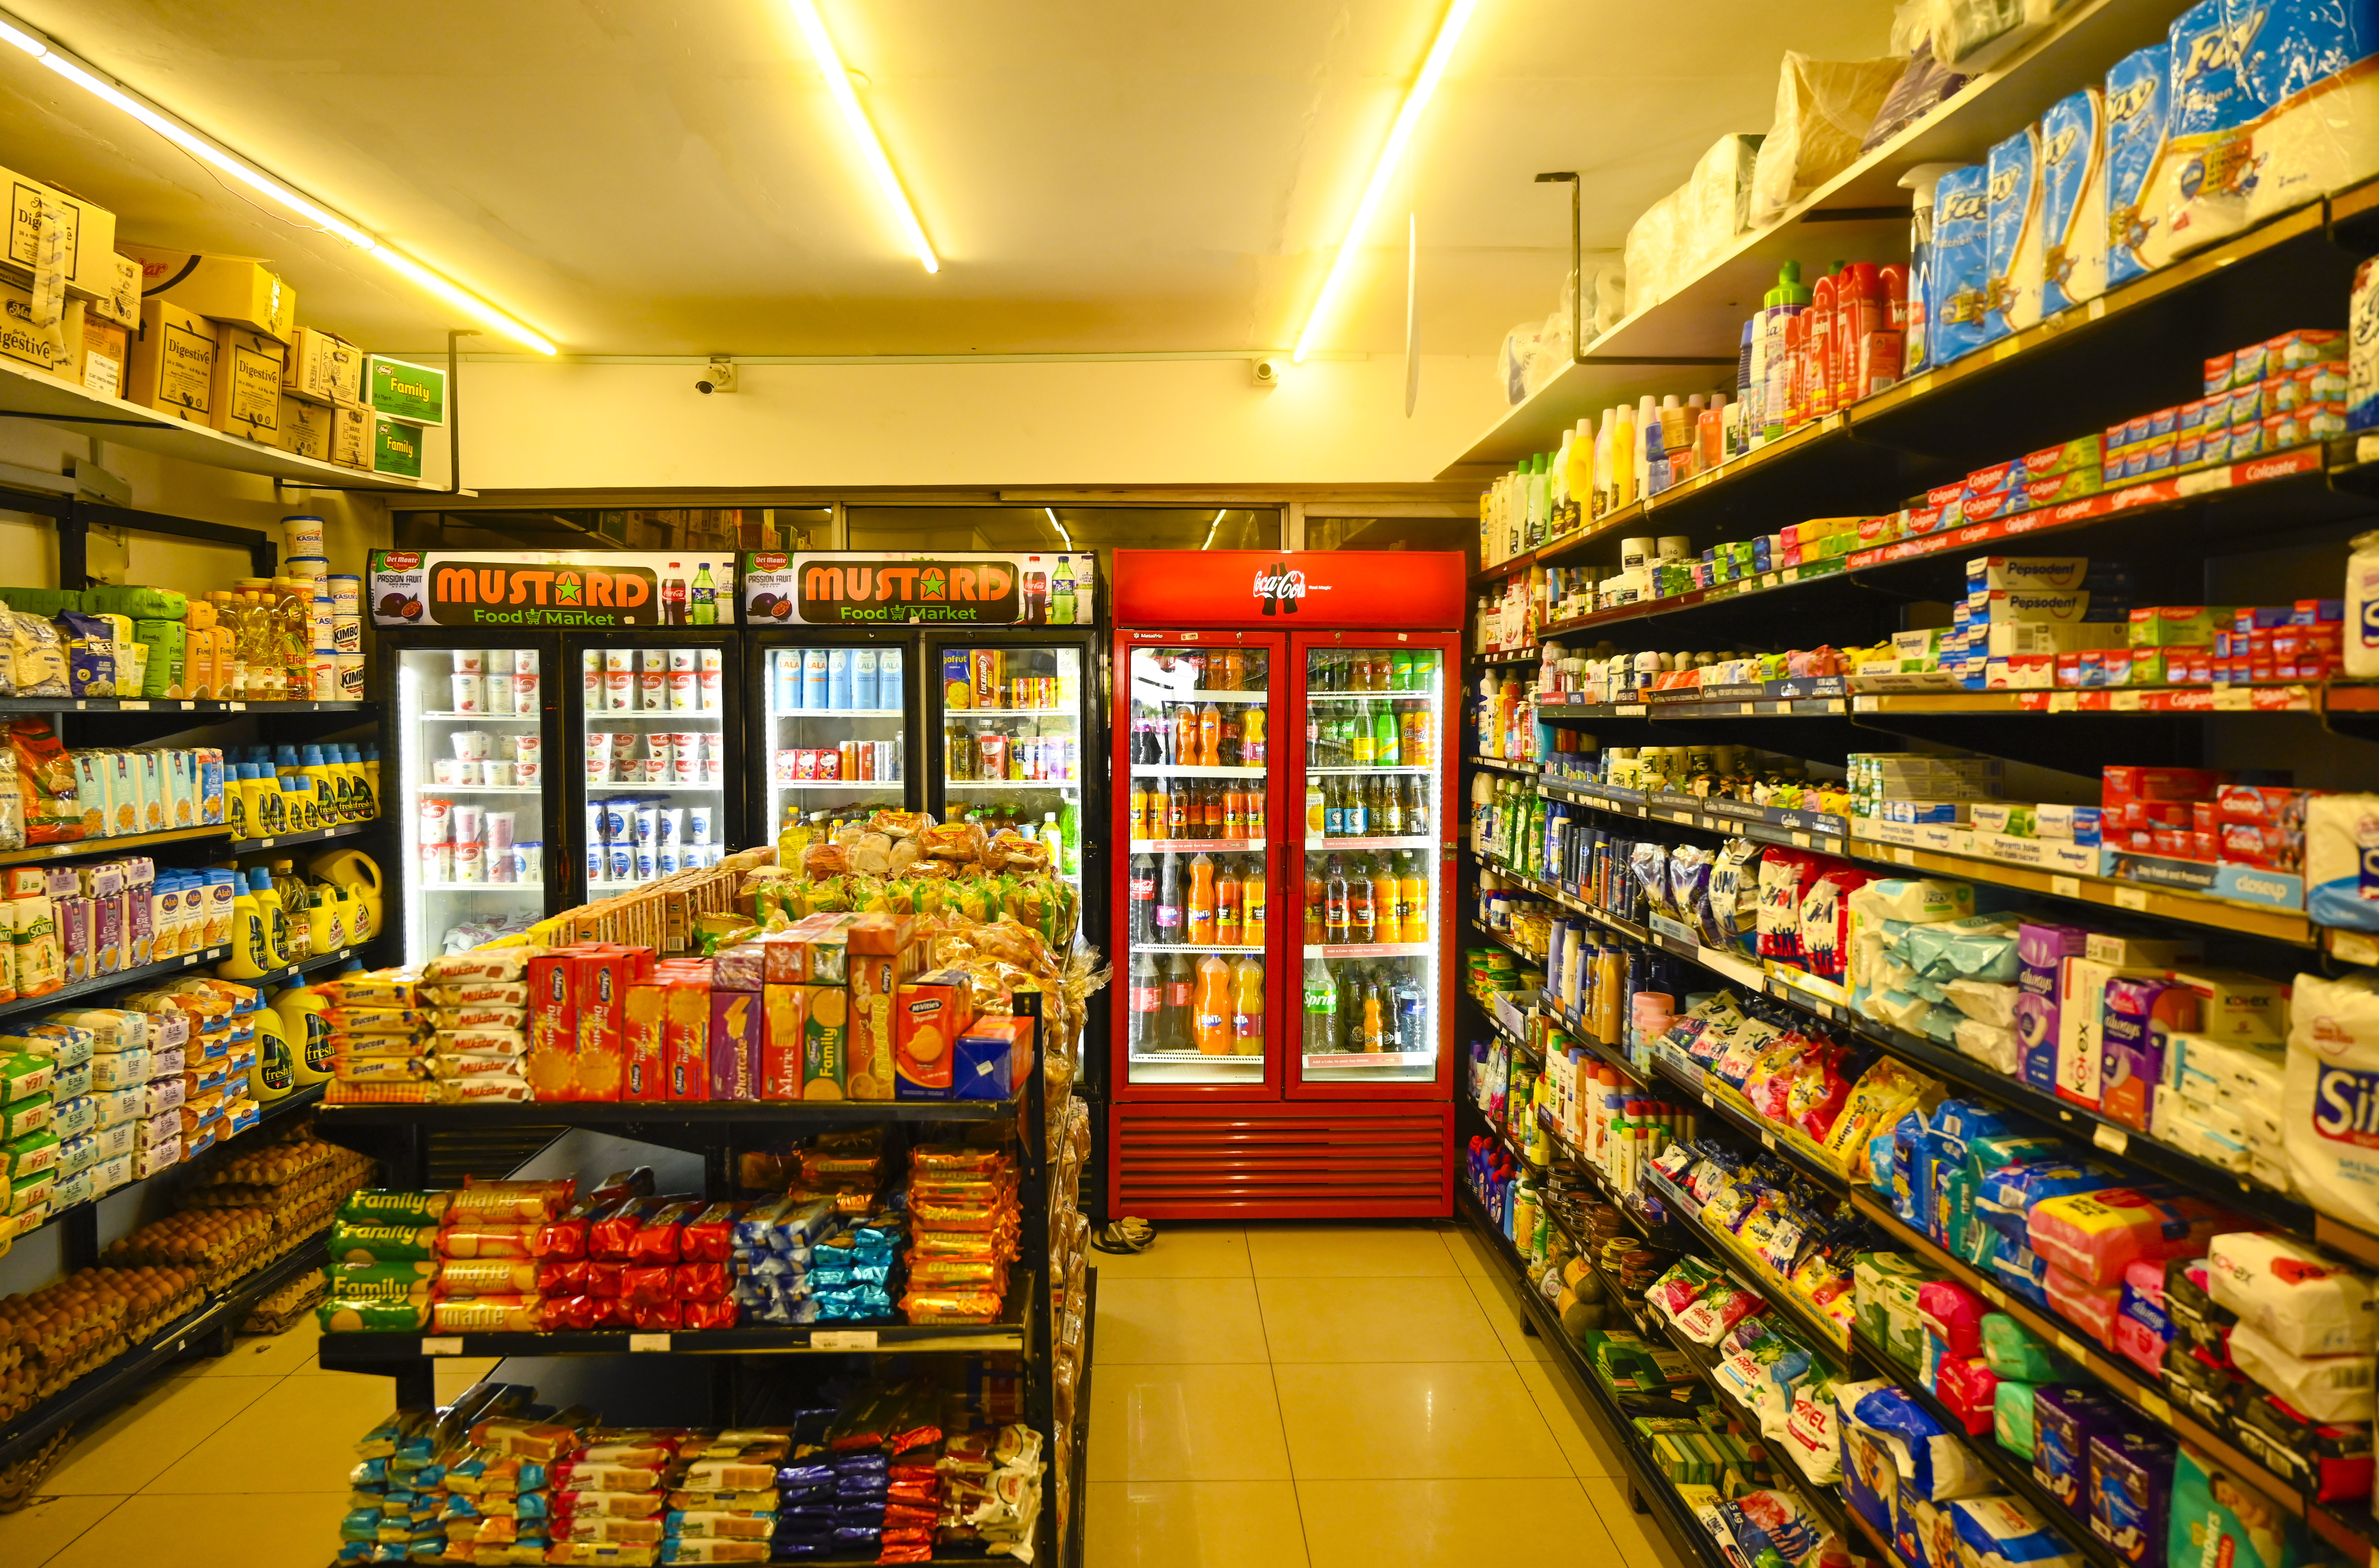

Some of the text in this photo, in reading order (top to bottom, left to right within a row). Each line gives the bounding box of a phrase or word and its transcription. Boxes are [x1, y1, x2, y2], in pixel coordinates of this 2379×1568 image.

[0, 326, 50, 359] igestive
[168, 338, 209, 364] Digestive
[239, 360, 277, 384] Digestive
[390, 377, 430, 403] Family
[387, 436, 414, 458] Family
[2027, 450, 2059, 468] Colgate
[2245, 458, 2297, 480] Colgate
[1967, 470, 2003, 488] Colgate
[2029, 479, 2061, 496] Colgate
[1928, 488, 1960, 503] Colgate
[1963, 497, 2001, 514] Colgate
[2056, 502, 2092, 519] Colgate
[1909, 513, 1938, 528] Colgate
[296, 532, 322, 542] KASUKU
[1960, 526, 1989, 541] Colgate
[2007, 562, 2076, 576] Pepsodent
[377, 574, 422, 583] PASSION FRUIT
[806, 567, 1011, 601] MUSTARD
[1253, 570, 1305, 599] Coca-Cola
[437, 568, 650, 608] MUSTARD
[2010, 595, 2077, 610] Pepsodent
[474, 609, 615, 626] Food Market
[841, 607, 977, 620] Food Market
[334, 626, 358, 640] KIMBO
[979, 661, 987, 695] Lucozade
[1570, 693, 1582, 703] NIVEA
[1321, 725, 1338, 734] Sprite
[83, 787, 99, 796] EXE
[320, 805, 334, 814] fresh
[1566, 882, 1577, 894] NIVEA
[1160, 908, 1177, 917] FANTA
[1193, 909, 1211, 919] FANTA
[30, 921, 53, 937] SOKO
[72, 931, 84, 940] EXE
[103, 925, 116, 934] EXE
[440, 964, 486, 978] Milkstar
[460, 988, 505, 1003] Milkstar
[1304, 991, 1336, 1007] Sprite
[460, 1012, 504, 1027] Milkstar
[1201, 1014, 1222, 1024] FANTA
[1567, 1007, 1578, 1020] NIVEA
[168, 1025, 180, 1033] EXE
[72, 1043, 86, 1052] EXE
[306, 1042, 335, 1061] fresh
[820, 1027, 838, 1077] Family
[735, 1032, 748, 1098] Shortcake
[778, 1048, 794, 1097] Marie
[68, 1076, 83, 1086] EXE
[266, 1068, 288, 1081] fresh
[462, 1084, 508, 1098] Milkstar
[123, 1095, 136, 1104] EXE
[69, 1111, 84, 1122] EXE
[1539, 1108, 1553, 1125] NIVEA
[161, 1145, 172, 1155] EXE
[353, 1191, 427, 1214] Family
[442, 1309, 504, 1326] marie
[1690, 1306, 1714, 1328] ARIEL
[1734, 1355, 1761, 1380] ARIEL
[1794, 1399, 1827, 1434] ARIEL
